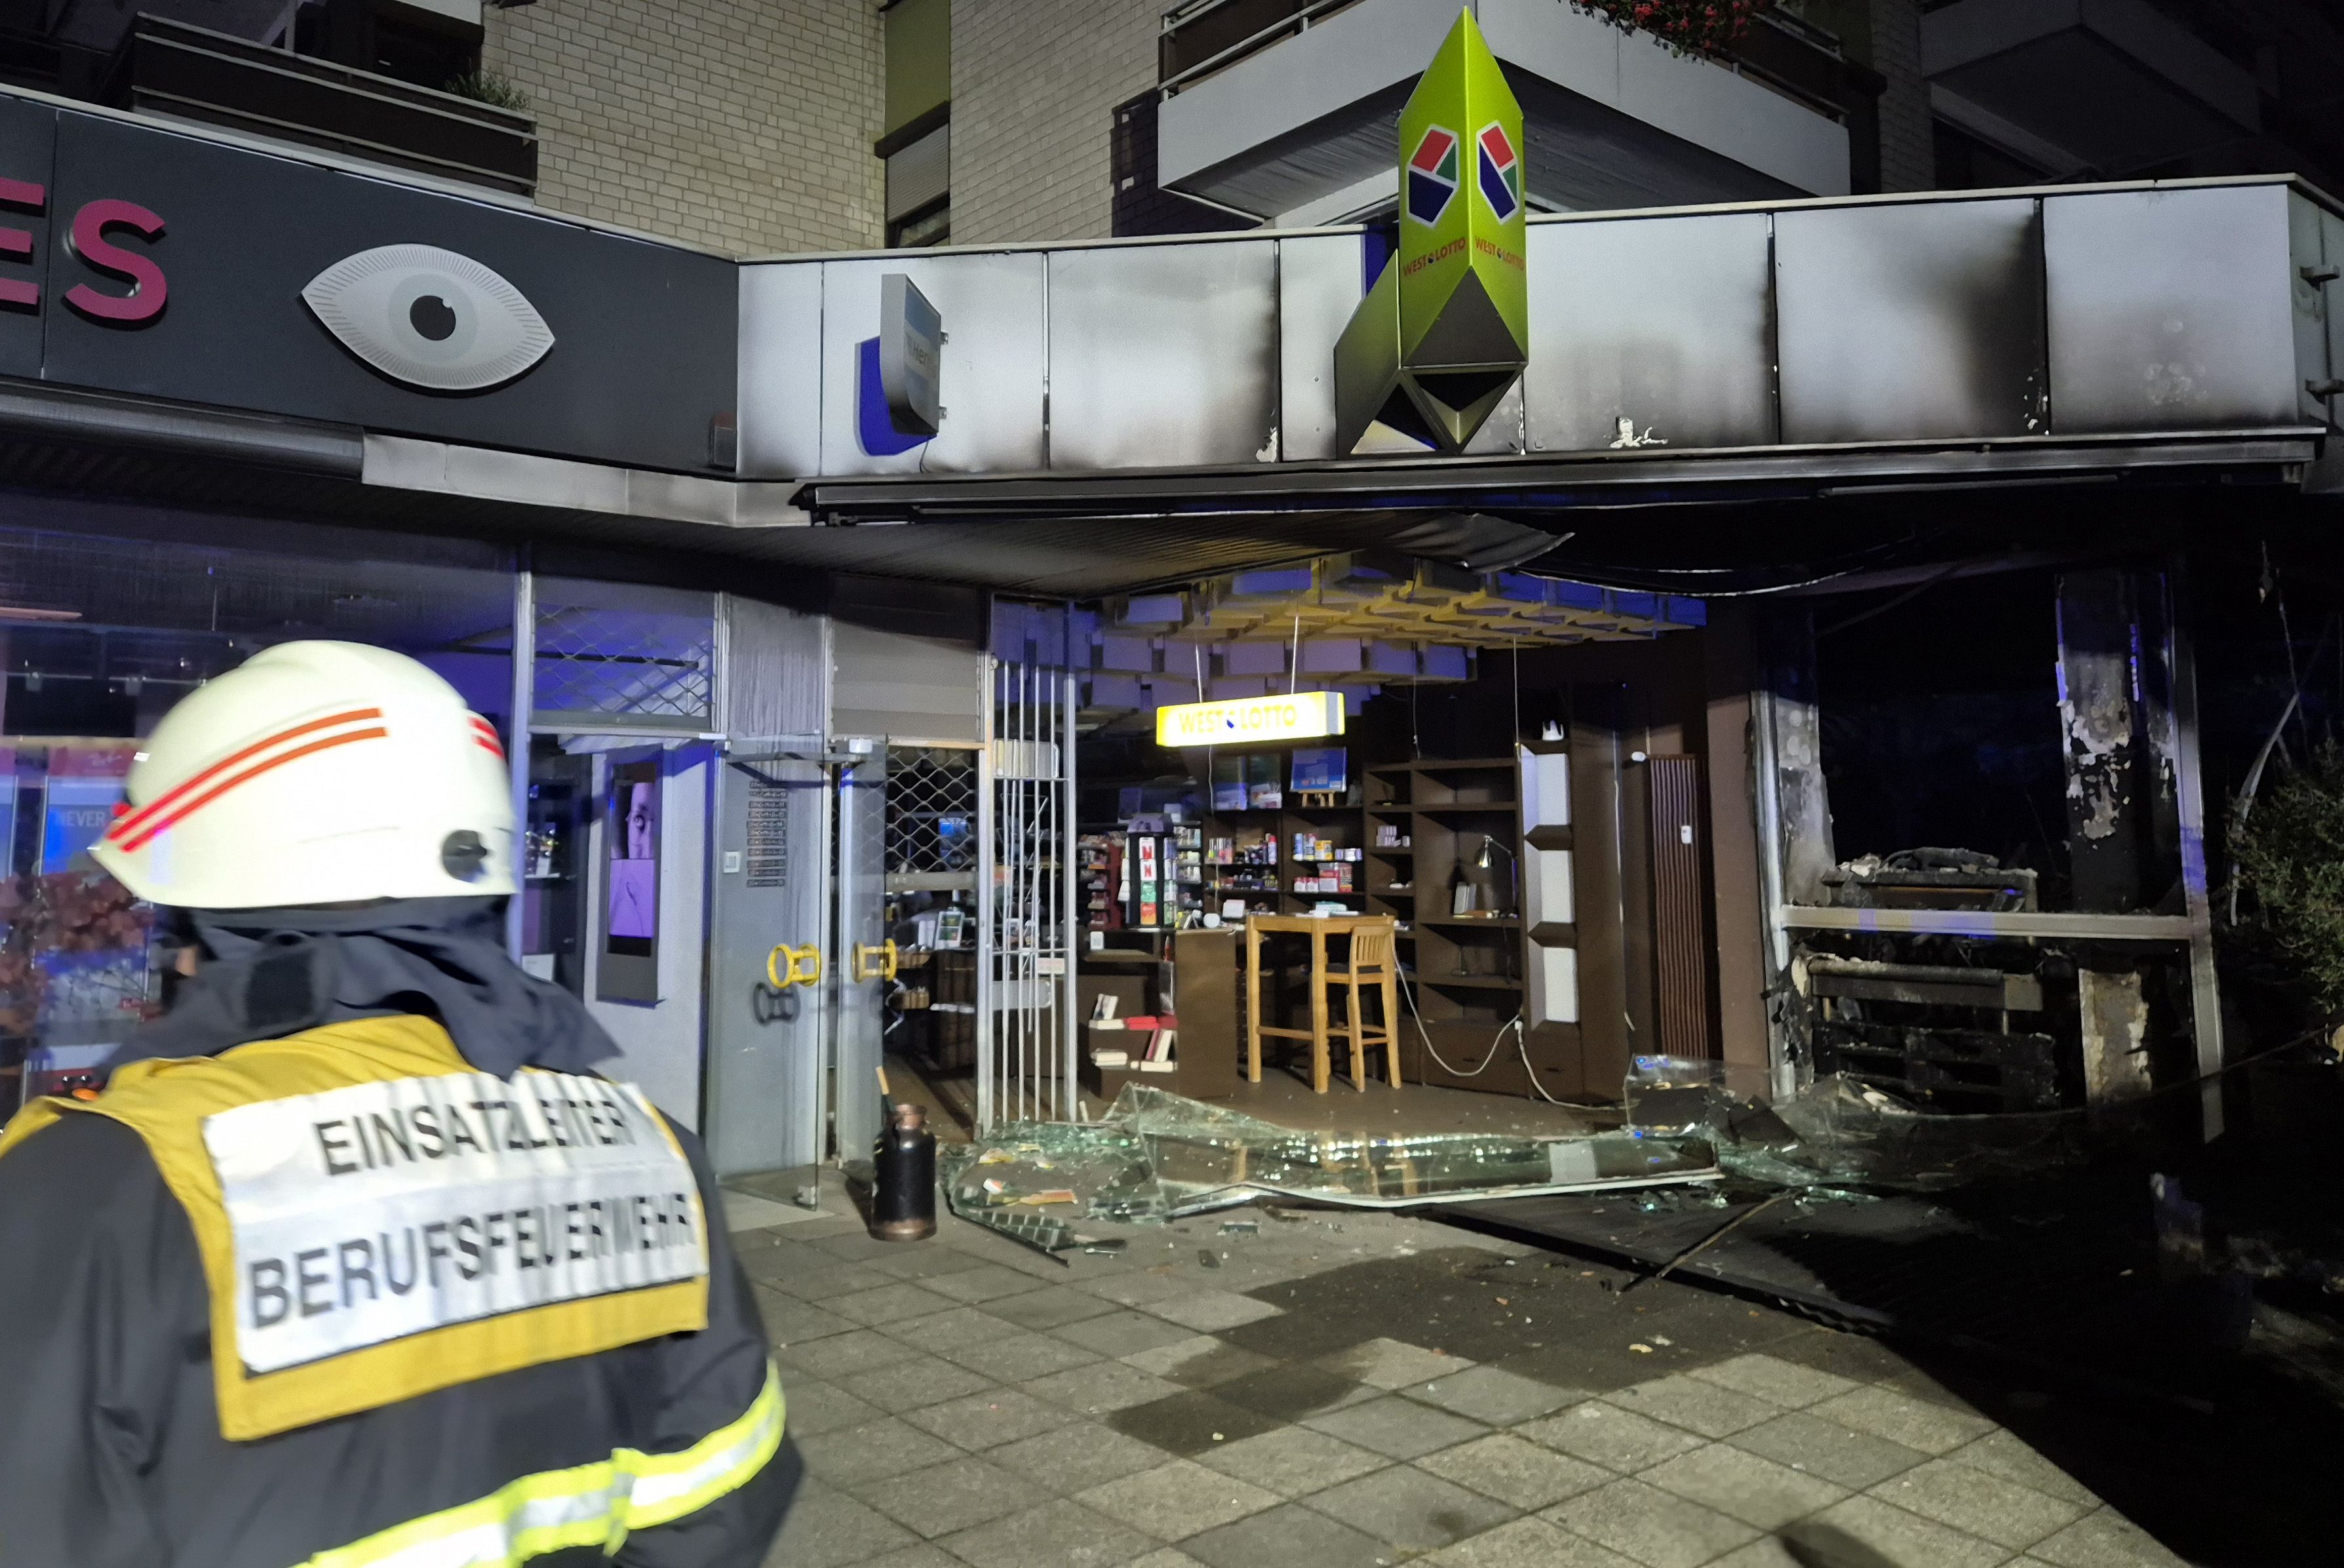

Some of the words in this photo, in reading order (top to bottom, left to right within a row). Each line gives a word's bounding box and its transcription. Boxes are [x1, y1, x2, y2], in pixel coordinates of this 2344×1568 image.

[1403, 254, 1428, 276] WEST
[1436, 237, 1466, 261] LOTTO
[1475, 237, 1496, 257] WEST
[1179, 709, 1225, 734] WEST
[1241, 703, 1298, 730] LOTTO
[312, 1099, 636, 1177] EINSATZLEITER
[246, 1192, 697, 1329] BERUFSFEUERWEHR
